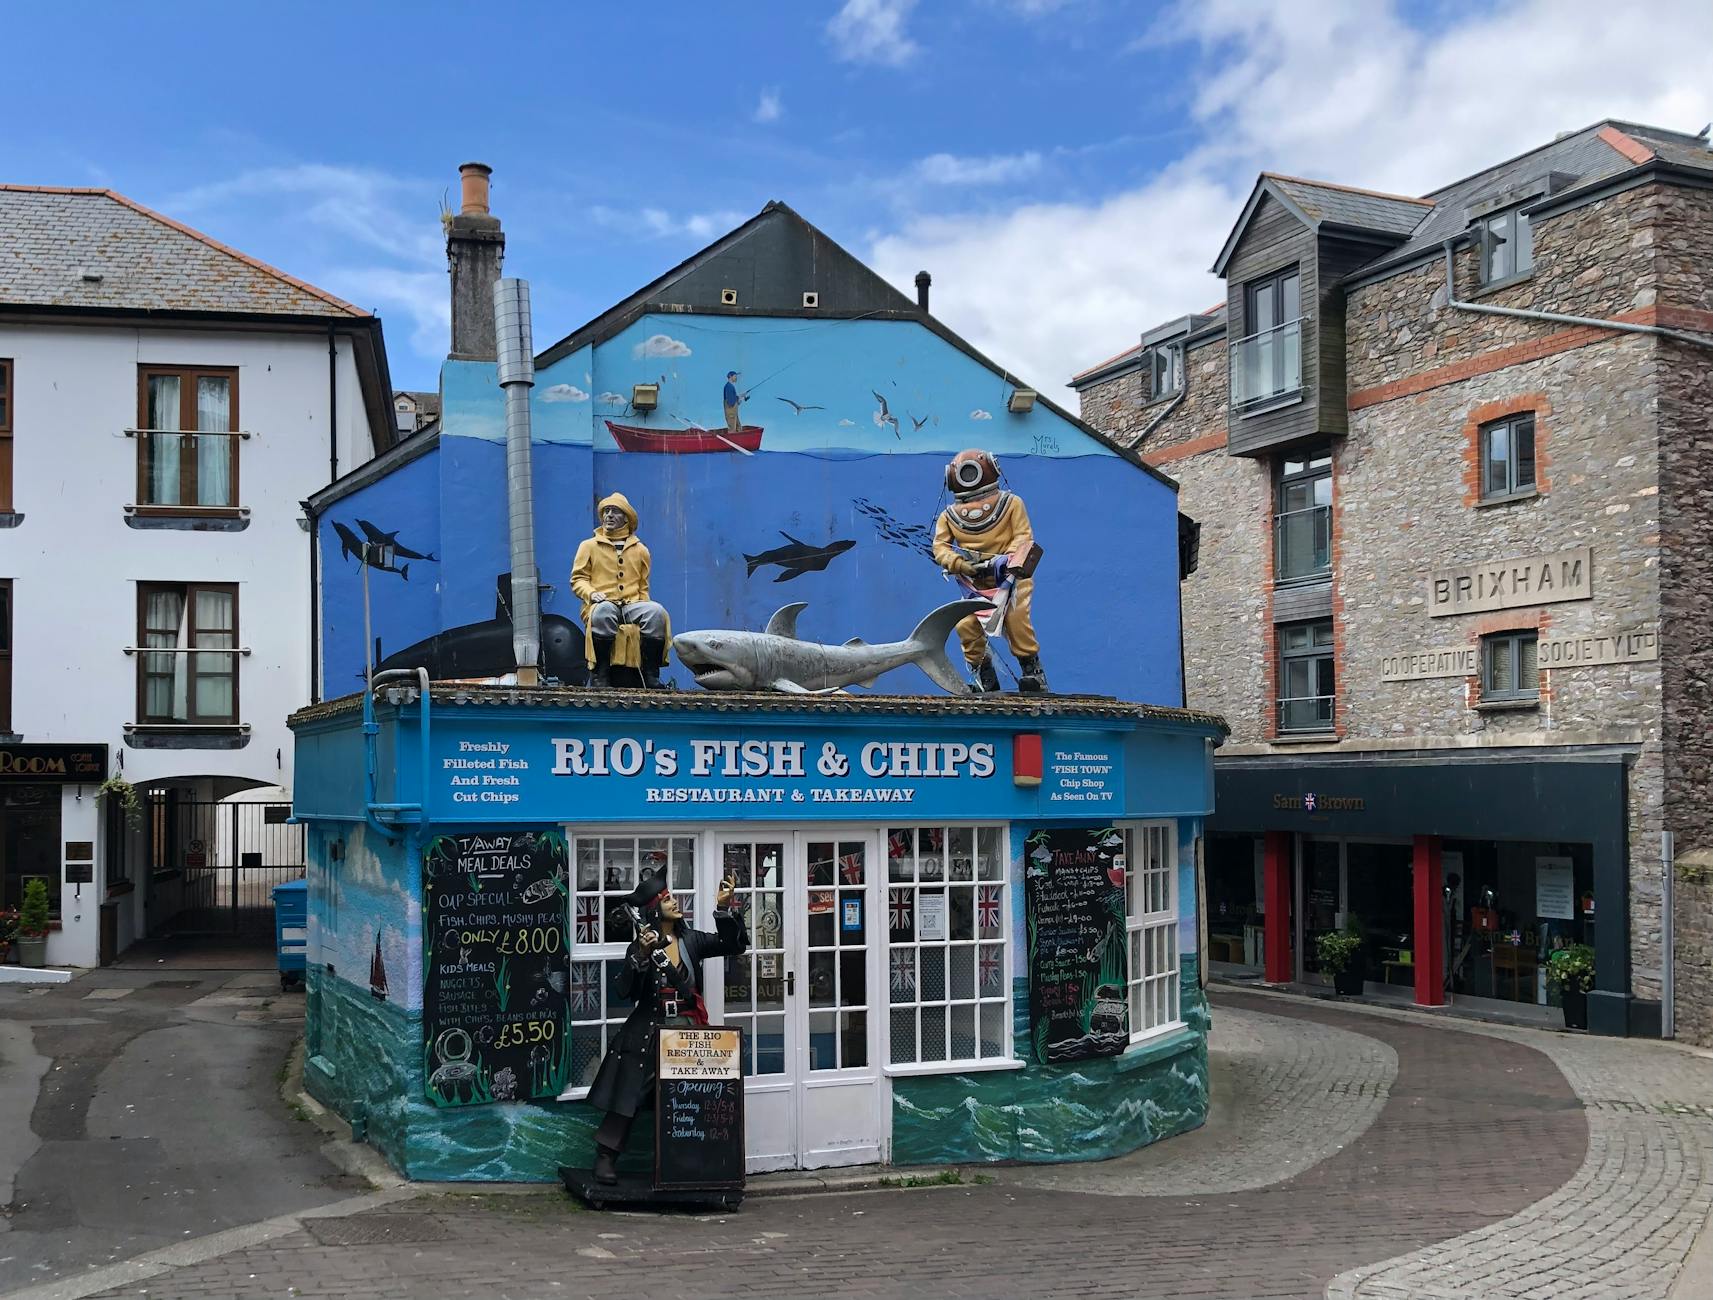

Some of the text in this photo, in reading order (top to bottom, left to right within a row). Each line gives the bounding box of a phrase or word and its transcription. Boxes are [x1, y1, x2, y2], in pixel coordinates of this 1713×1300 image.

[1434, 559, 1582, 604] BRIXHAM
[1539, 635, 1622, 663] SOCIETY
[459, 741, 510, 754] Freshly
[551, 738, 997, 778] RIO's FISH & CHIPS
[1055, 752, 1108, 760] The Famous
[443, 758, 529, 769] Filleted Fish
[450, 775, 520, 786] And Fresh
[1060, 778, 1105, 789] Chip Shop
[453, 791, 519, 804] Cut Chips
[646, 788, 916, 803] RESTAURANT & TAKEAWAY
[1050, 792, 1113, 801] As Seen On TV
[1273, 793, 1364, 810] Sam Brown
[457, 854, 532, 873] MEAL DEALS
[439, 892, 513, 909] OAP SPECIAL
[502, 913, 534, 927] MUSHY
[537, 913, 563, 924] PEAS
[461, 927, 560, 954] ONLY £8.00
[440, 962, 496, 974] KIDS MEALS
[494, 1020, 555, 1049] £5.50
[679, 1032, 722, 1040] THE RIO
[688, 1041, 711, 1049] FISH
[667, 1049, 733, 1058] RESTAURANT
[696, 1058, 704, 1066] &
[671, 1067, 730, 1075] TAKE AWAY
[677, 1081, 725, 1099] Opening
[671, 1097, 700, 1113] Thursday
[672, 1111, 695, 1126] Friday
[671, 1126, 706, 1141] Saturday
